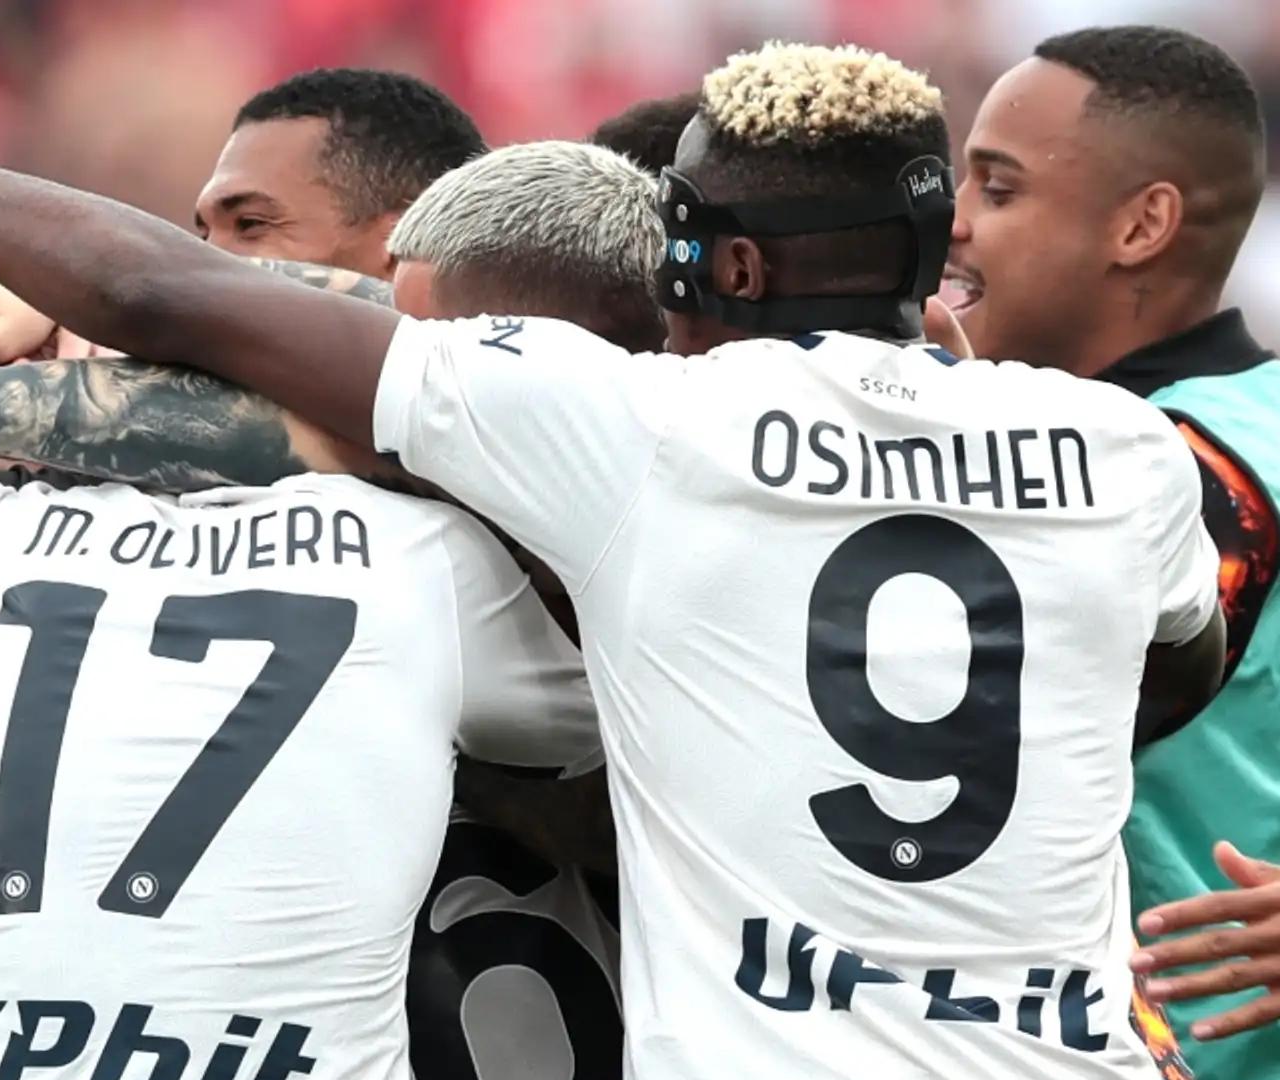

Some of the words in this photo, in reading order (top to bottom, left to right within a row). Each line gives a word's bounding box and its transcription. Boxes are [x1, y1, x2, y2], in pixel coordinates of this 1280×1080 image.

[860, 377, 916, 401] SSCN
[751, 409, 1094, 509] OSIMHEN
[23, 504, 90, 556] M.
[111, 506, 371, 575] OLIVERA
[806, 513, 1024, 883] 9
